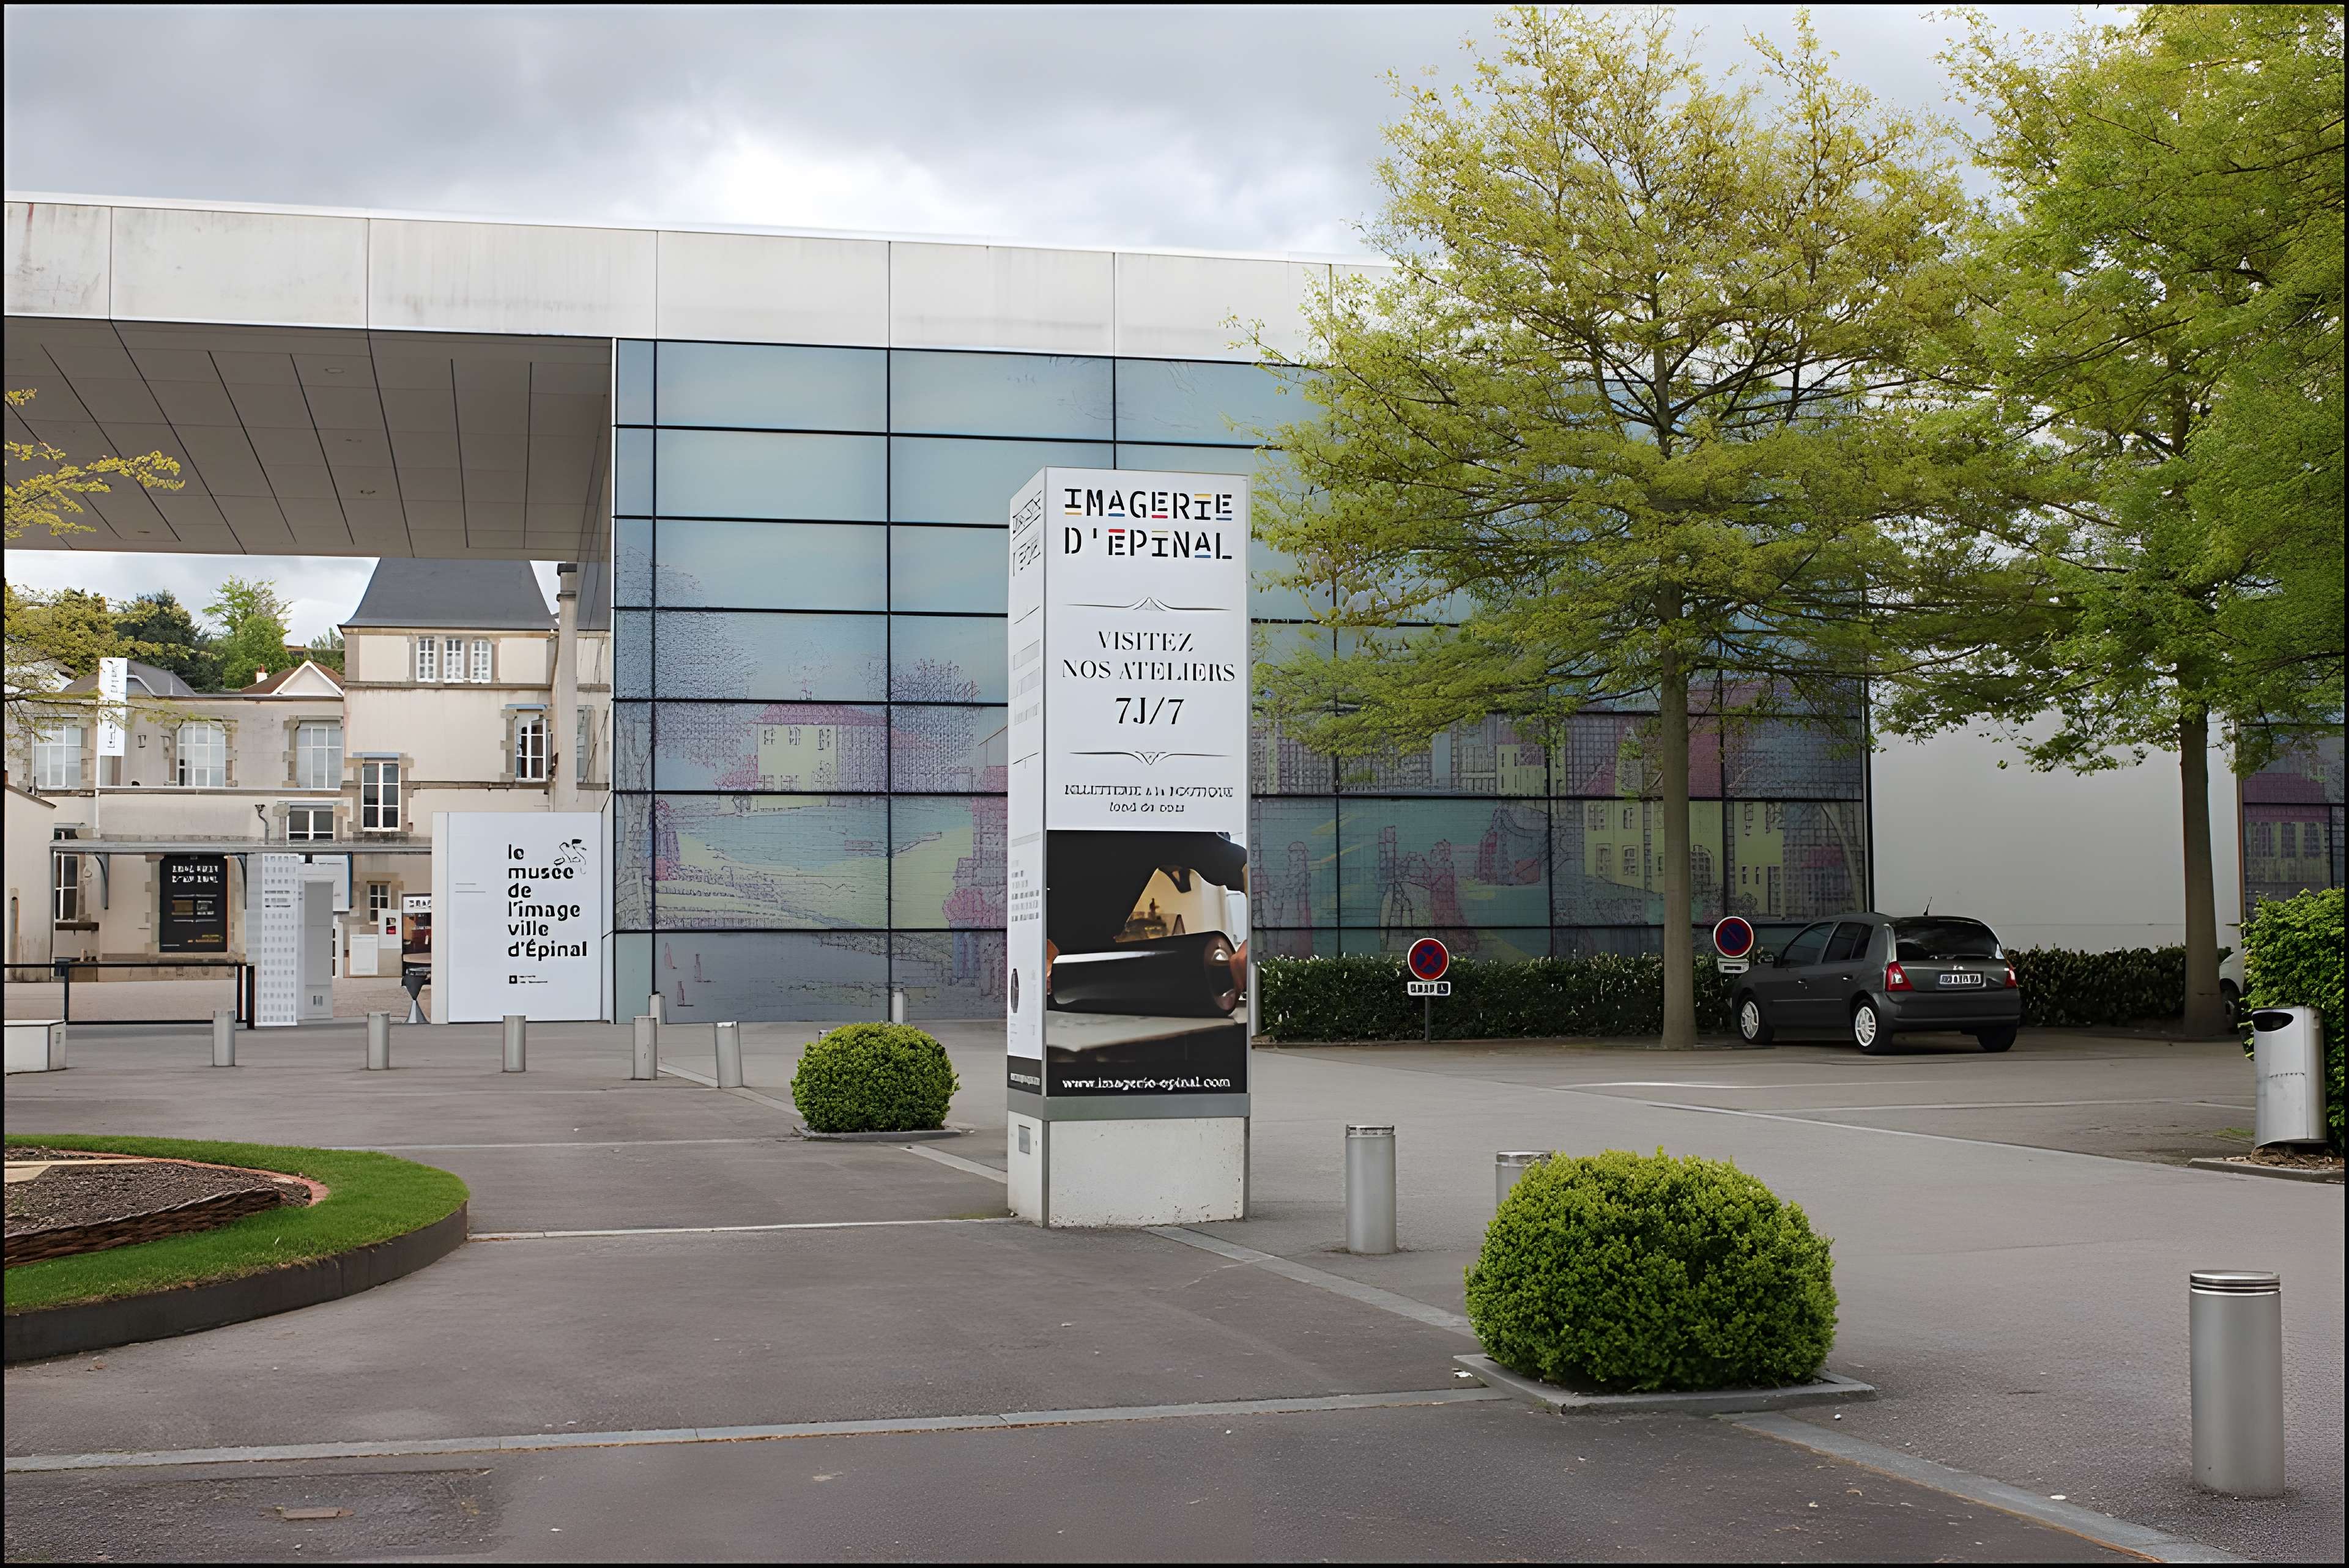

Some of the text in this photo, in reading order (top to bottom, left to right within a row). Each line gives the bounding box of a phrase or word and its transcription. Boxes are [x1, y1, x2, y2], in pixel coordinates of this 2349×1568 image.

[1064, 489, 1233, 521] IMAGERIE
[1099, 631, 1193, 652] VISITEZ
[1063, 659, 1235, 682] NOS ATELIERS
[1115, 697, 1184, 725] 7J/7
[508, 844, 524, 860] le
[508, 882, 532, 898] de
[508, 901, 581, 922] l'image
[508, 920, 549, 937] ville
[508, 939, 587, 961] d'Épinal
